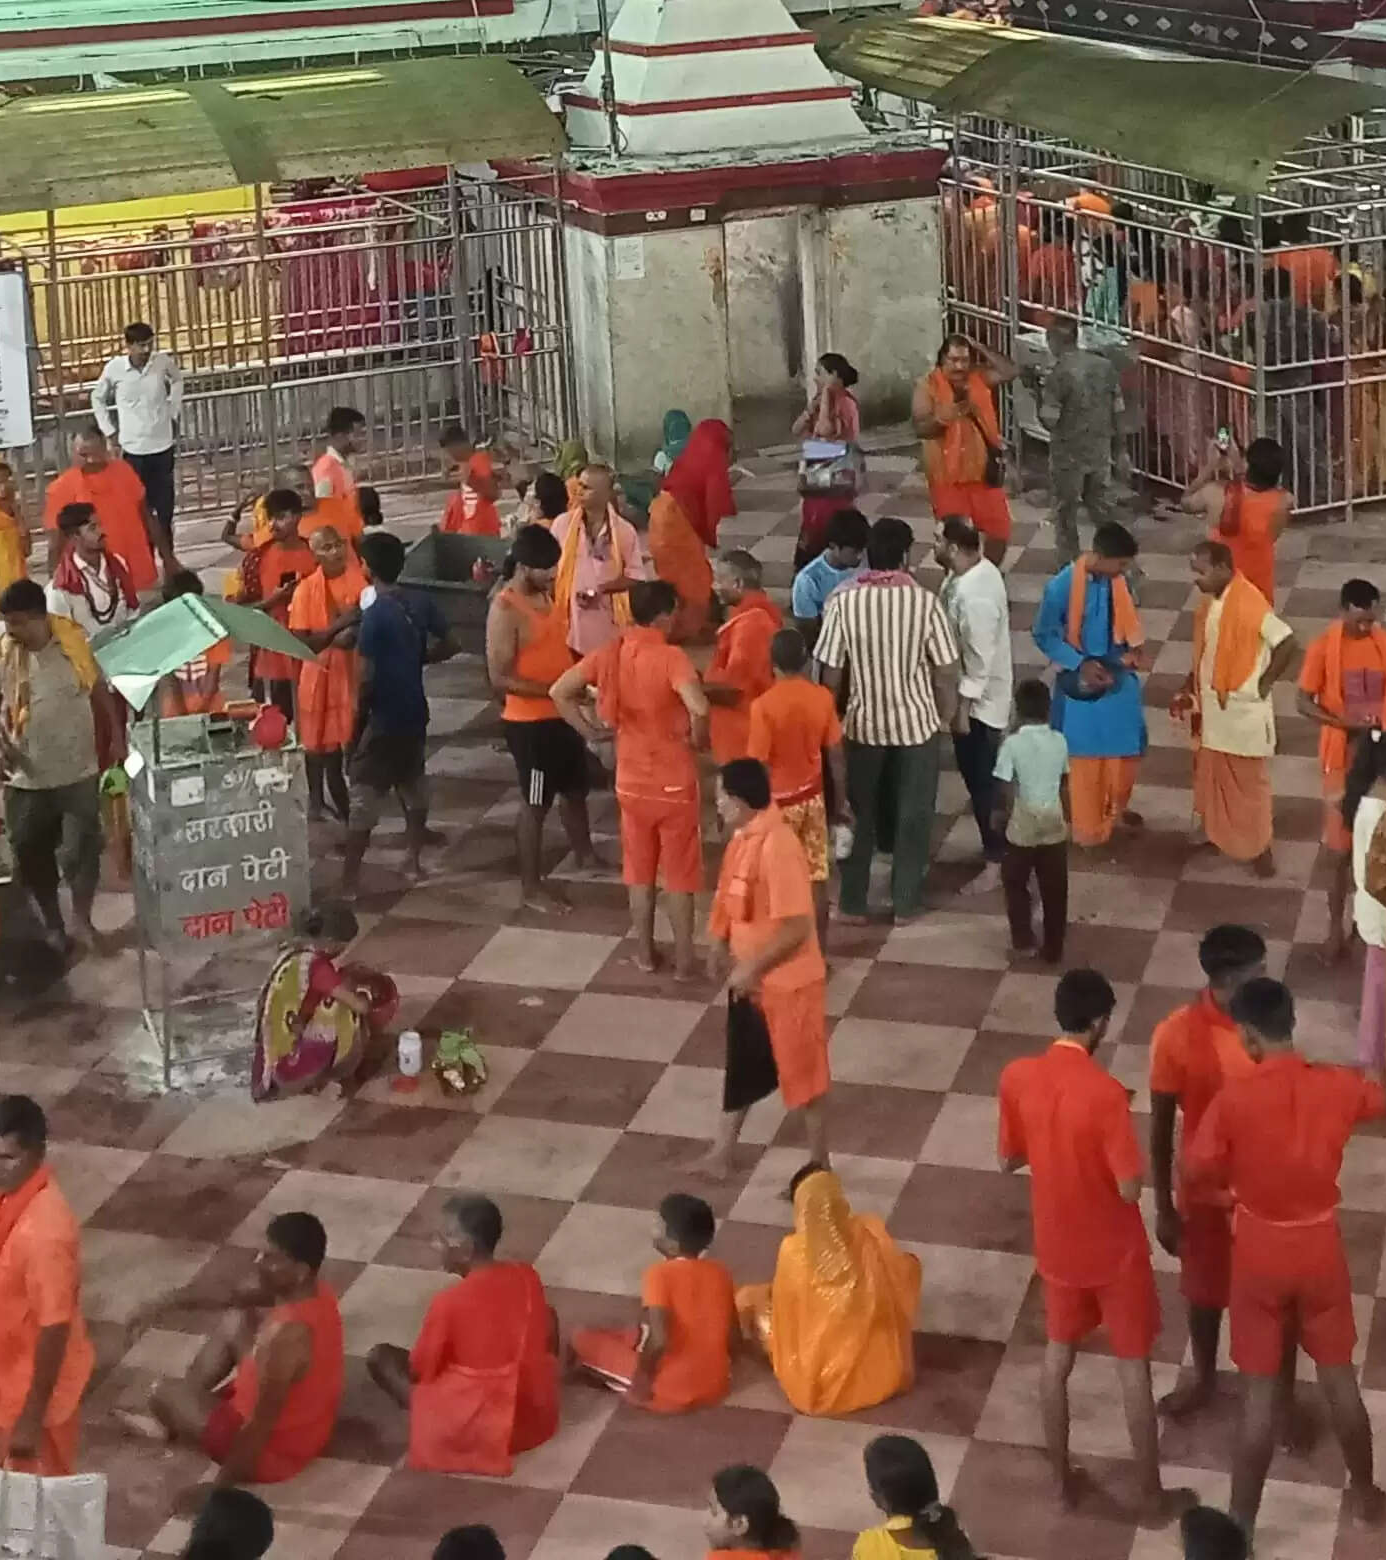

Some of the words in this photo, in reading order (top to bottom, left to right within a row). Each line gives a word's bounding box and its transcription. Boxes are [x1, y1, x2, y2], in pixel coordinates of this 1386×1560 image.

[185, 801, 277, 843] सरकारी
[179, 865, 232, 894] दान
[241, 847, 292, 883] पेटी
[179, 910, 235, 940] दान
[243, 892, 290, 929] पेटी
